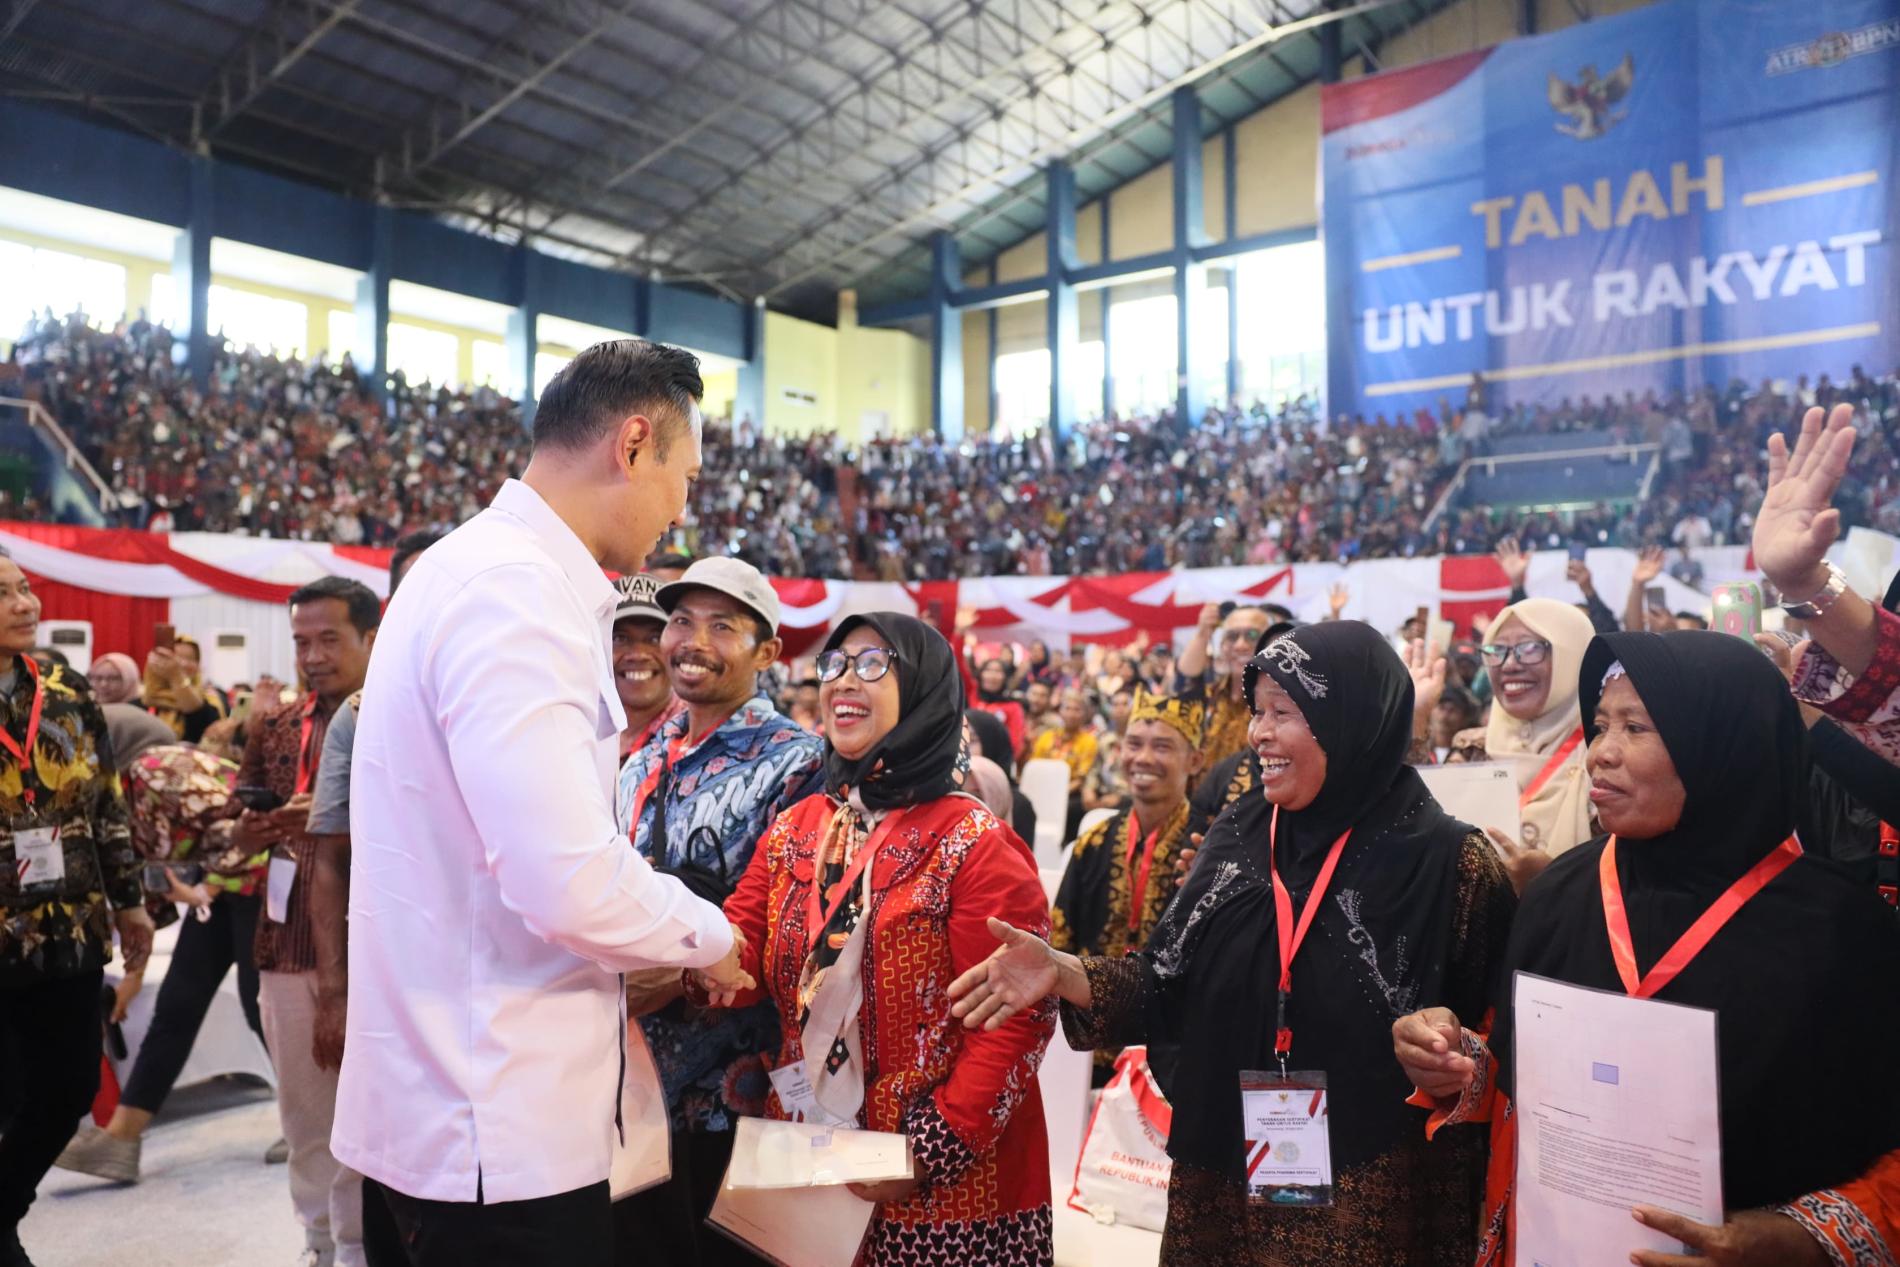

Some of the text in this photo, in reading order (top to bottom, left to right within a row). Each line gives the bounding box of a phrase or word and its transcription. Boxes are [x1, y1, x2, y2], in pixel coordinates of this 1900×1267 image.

[1472, 155, 1725, 249] TANAH
[1363, 229, 1882, 353] UNTUK RAKYAT
[1099, 1165, 1153, 1187] REPUBLIK
[1111, 1151, 1163, 1172] BANTUAN
